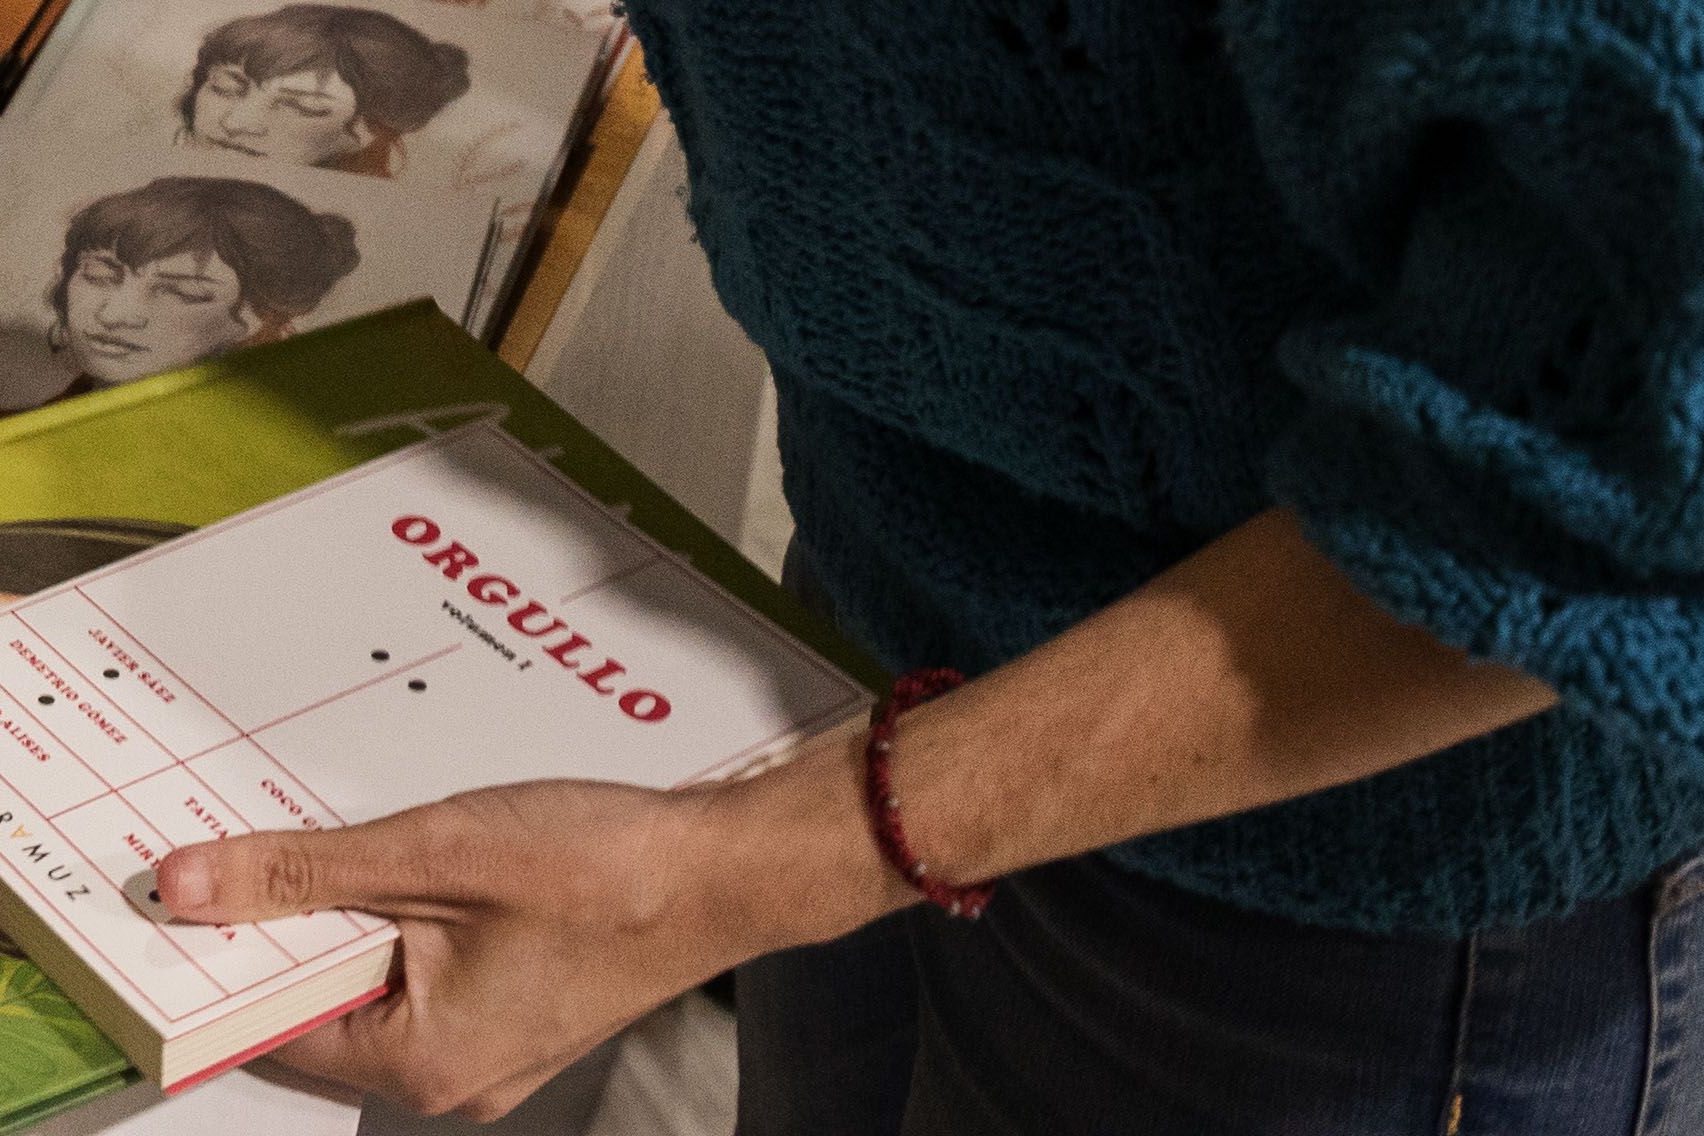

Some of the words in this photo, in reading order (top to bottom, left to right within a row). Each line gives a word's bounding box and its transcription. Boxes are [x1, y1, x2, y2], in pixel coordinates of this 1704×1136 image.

[391, 514, 672, 723] ORGULLO
[9, 639, 79, 701] DEMETRIO
[78, 702, 128, 744] GÓMEZ
[88, 628, 140, 671] JAVIER
[138, 672, 176, 704] SÁEZ
[0, 720, 51, 762] ALISES
[185, 797, 229, 840] TATIA
[259, 779, 303, 816] COCO
